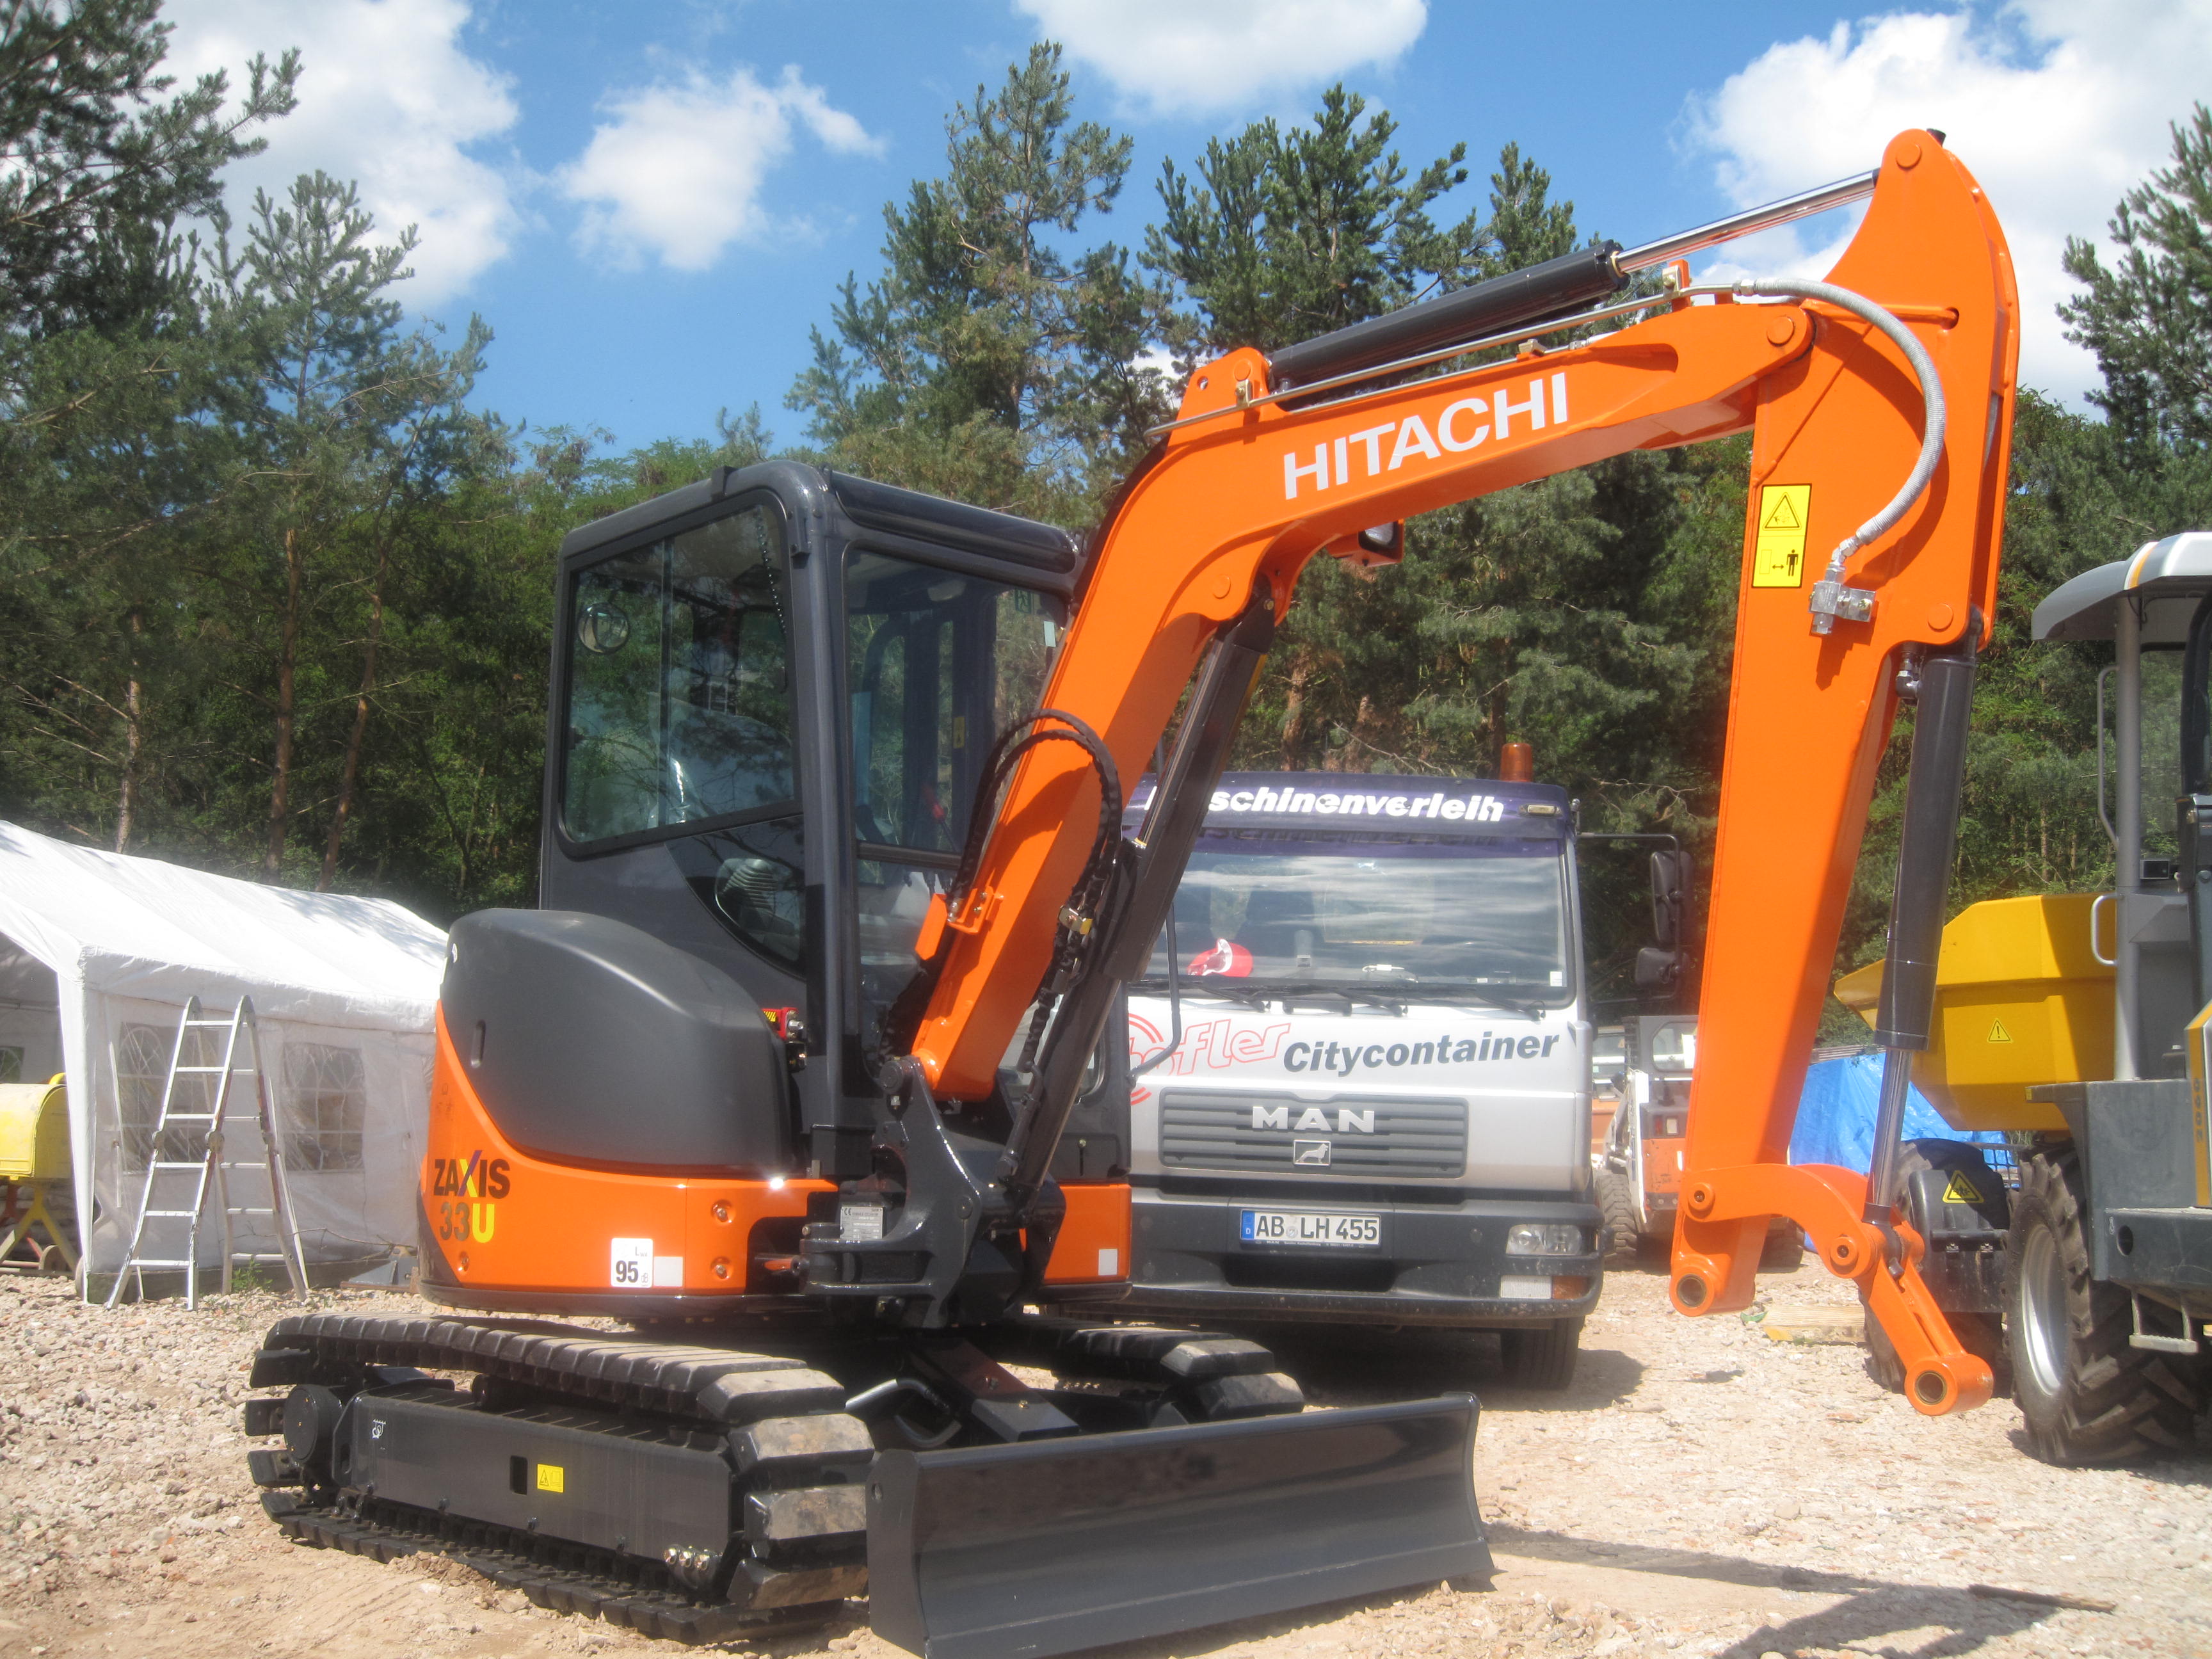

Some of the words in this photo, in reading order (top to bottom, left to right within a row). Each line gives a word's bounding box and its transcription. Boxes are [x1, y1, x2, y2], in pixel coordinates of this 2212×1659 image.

[1283, 372, 1567, 500] HITACHI
[1144, 785, 1504, 822] schinenverleih
[1283, 1030, 1560, 1077] Citycontainer
[1252, 1106, 1375, 1133] MAN
[433, 1150, 511, 1199] ZAXIS
[440, 1202, 495, 1243] 33U
[1256, 1215, 1285, 1237] AB
[1301, 1217, 1329, 1240] LH
[1336, 1218, 1378, 1241] 455
[616, 1260, 639, 1283] 95
